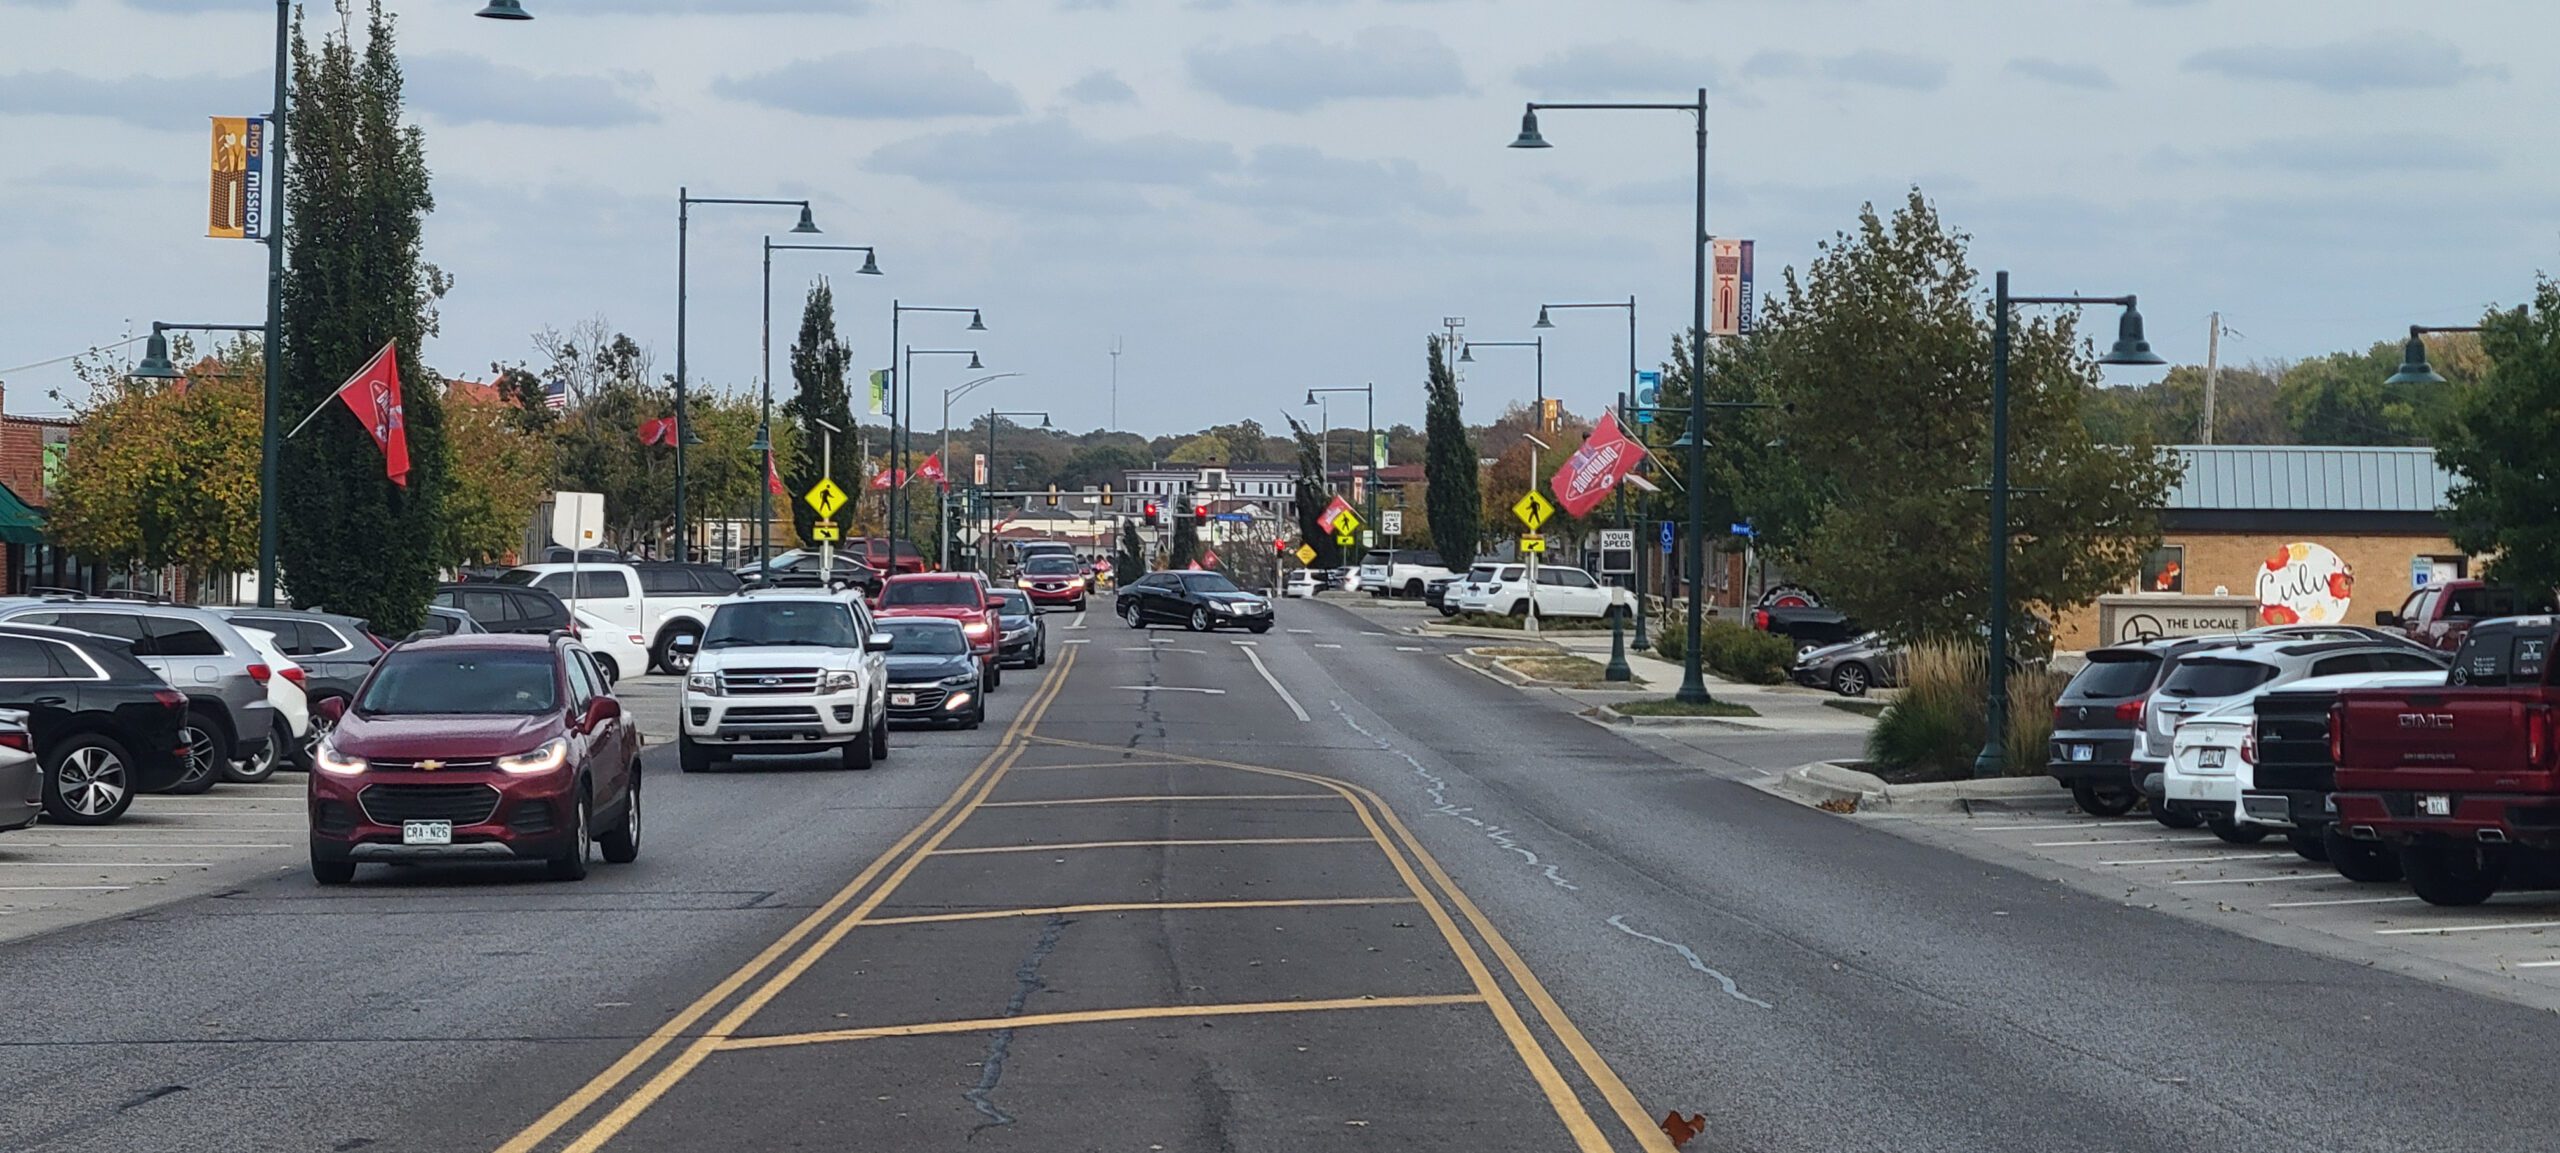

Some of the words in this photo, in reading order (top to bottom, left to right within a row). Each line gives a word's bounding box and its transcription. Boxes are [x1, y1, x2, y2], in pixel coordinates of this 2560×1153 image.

[248, 124, 261, 157] shop
[246, 171, 260, 234] mission
[1741, 281, 1752, 332] mission
[1384, 522, 1400, 532] 25
[1604, 540, 1631, 548] SPEED
[2167, 618, 2189, 629] THE
[2193, 618, 2239, 630] LOCALE
[2398, 713, 2454, 728] GMC
